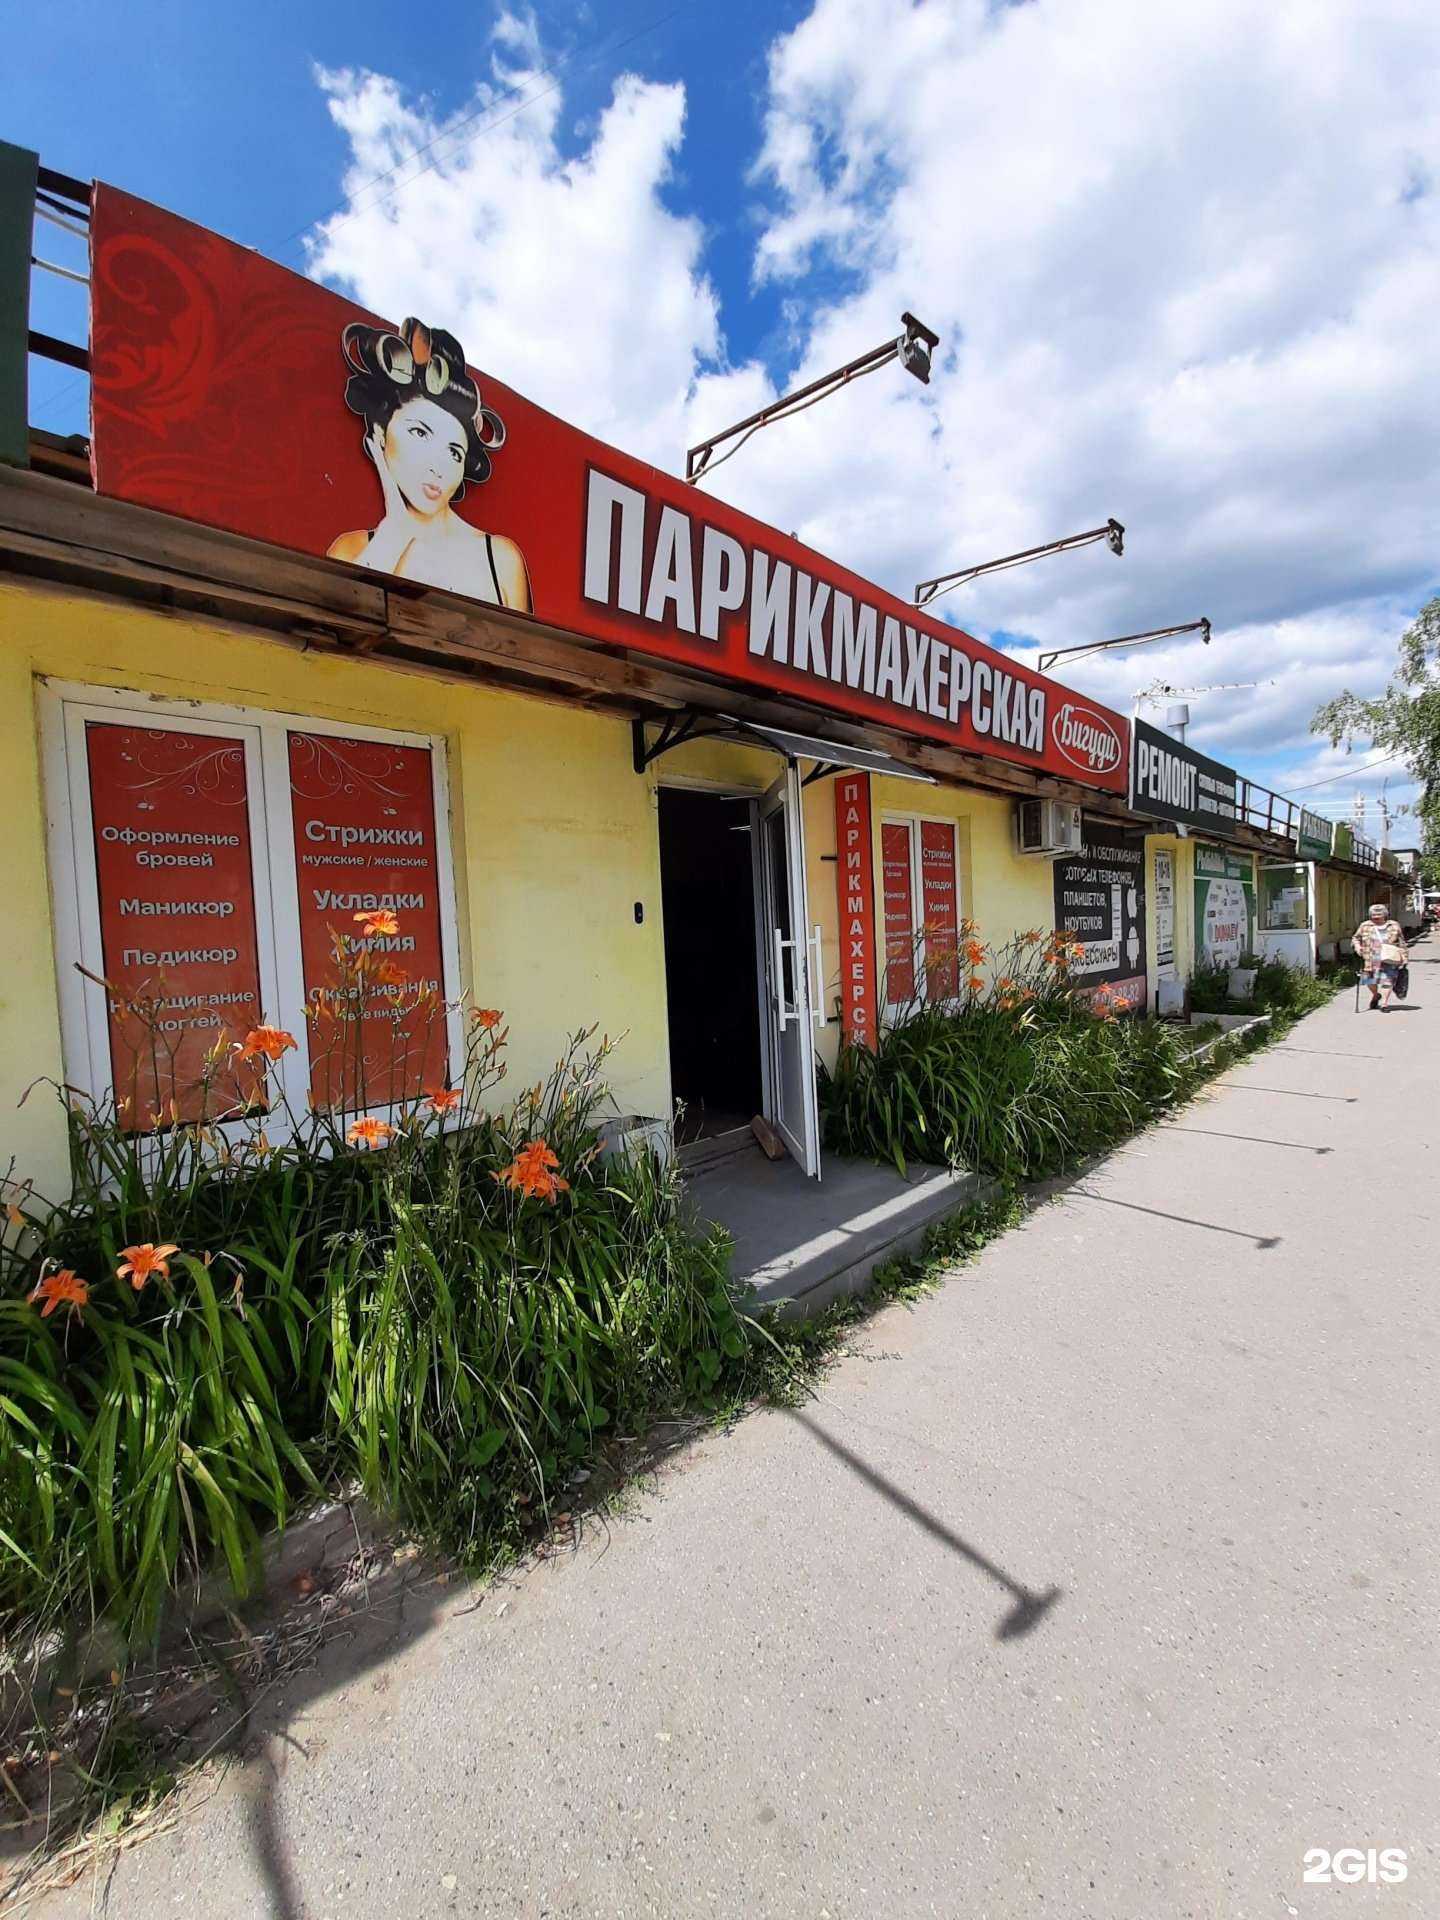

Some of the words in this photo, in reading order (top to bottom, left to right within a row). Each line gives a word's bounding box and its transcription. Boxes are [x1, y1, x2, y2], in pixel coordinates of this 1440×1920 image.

[584, 468, 1047, 754] ПАРИКМАХЕРСКАЯ
[1060, 704, 1117, 768] Бигуди
[1137, 739, 1198, 812] РЕМОНТ
[101, 826, 240, 848] Оформление
[305, 820, 424, 847] Стрижки
[136, 850, 214, 868] бровей
[374, 856, 429, 868] женские
[120, 898, 235, 918] Маникюр
[312, 890, 425, 913] Укладки
[122, 946, 238, 968] Педикюр
